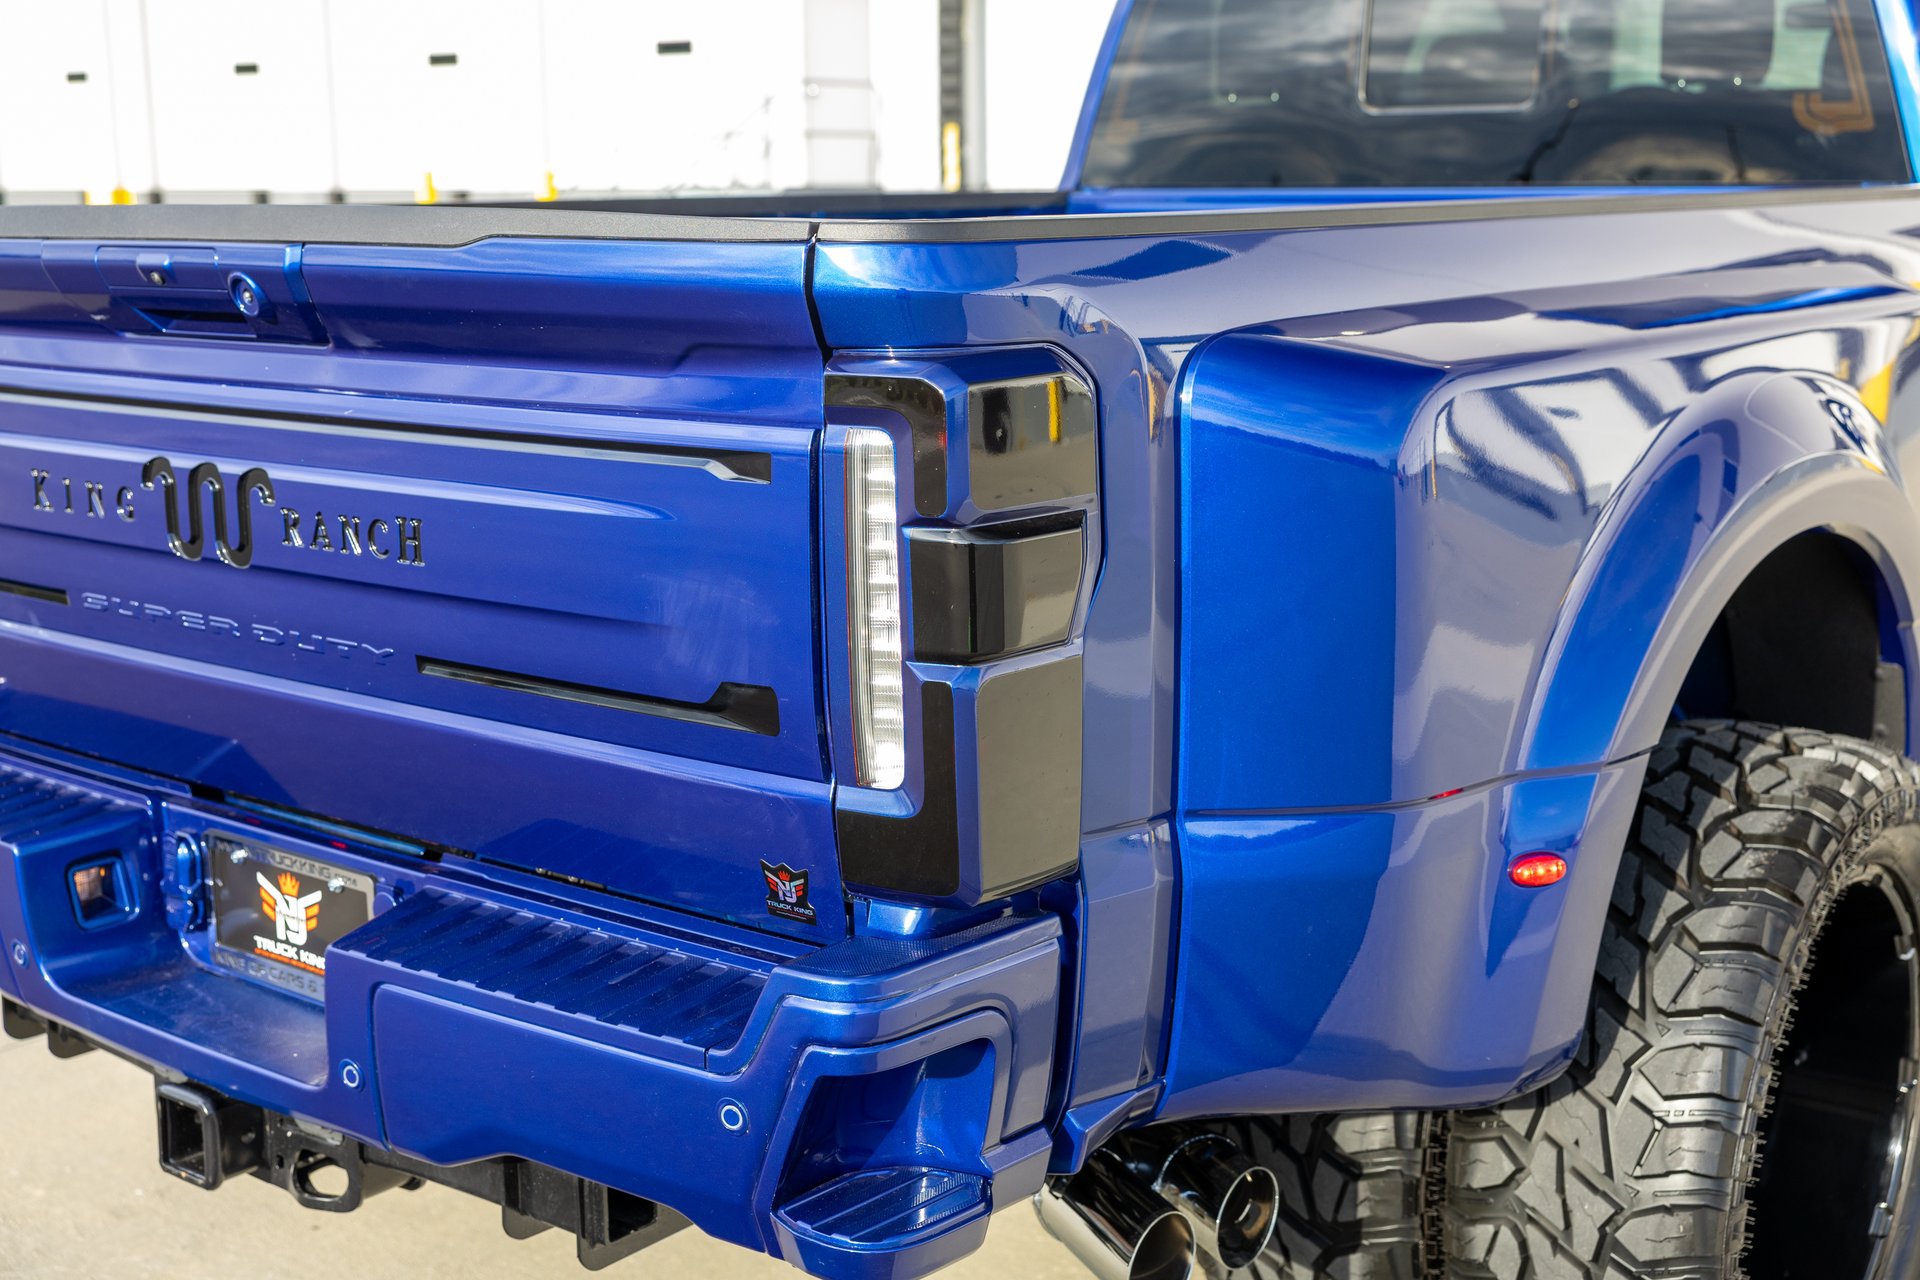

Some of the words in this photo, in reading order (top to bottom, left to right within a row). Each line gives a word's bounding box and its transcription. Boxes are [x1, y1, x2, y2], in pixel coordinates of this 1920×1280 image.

[30, 467, 136, 523] KING
[279, 506, 426, 567] RANCH
[81, 591, 241, 638] SUPER
[251, 623, 395, 665] DUTY
[766, 899, 793, 911] TRUCK
[793, 907, 814, 916] KING
[253, 935, 299, 960] TRUCK
[299, 949, 326, 969] KIN
[268, 966, 305, 989] CARS
